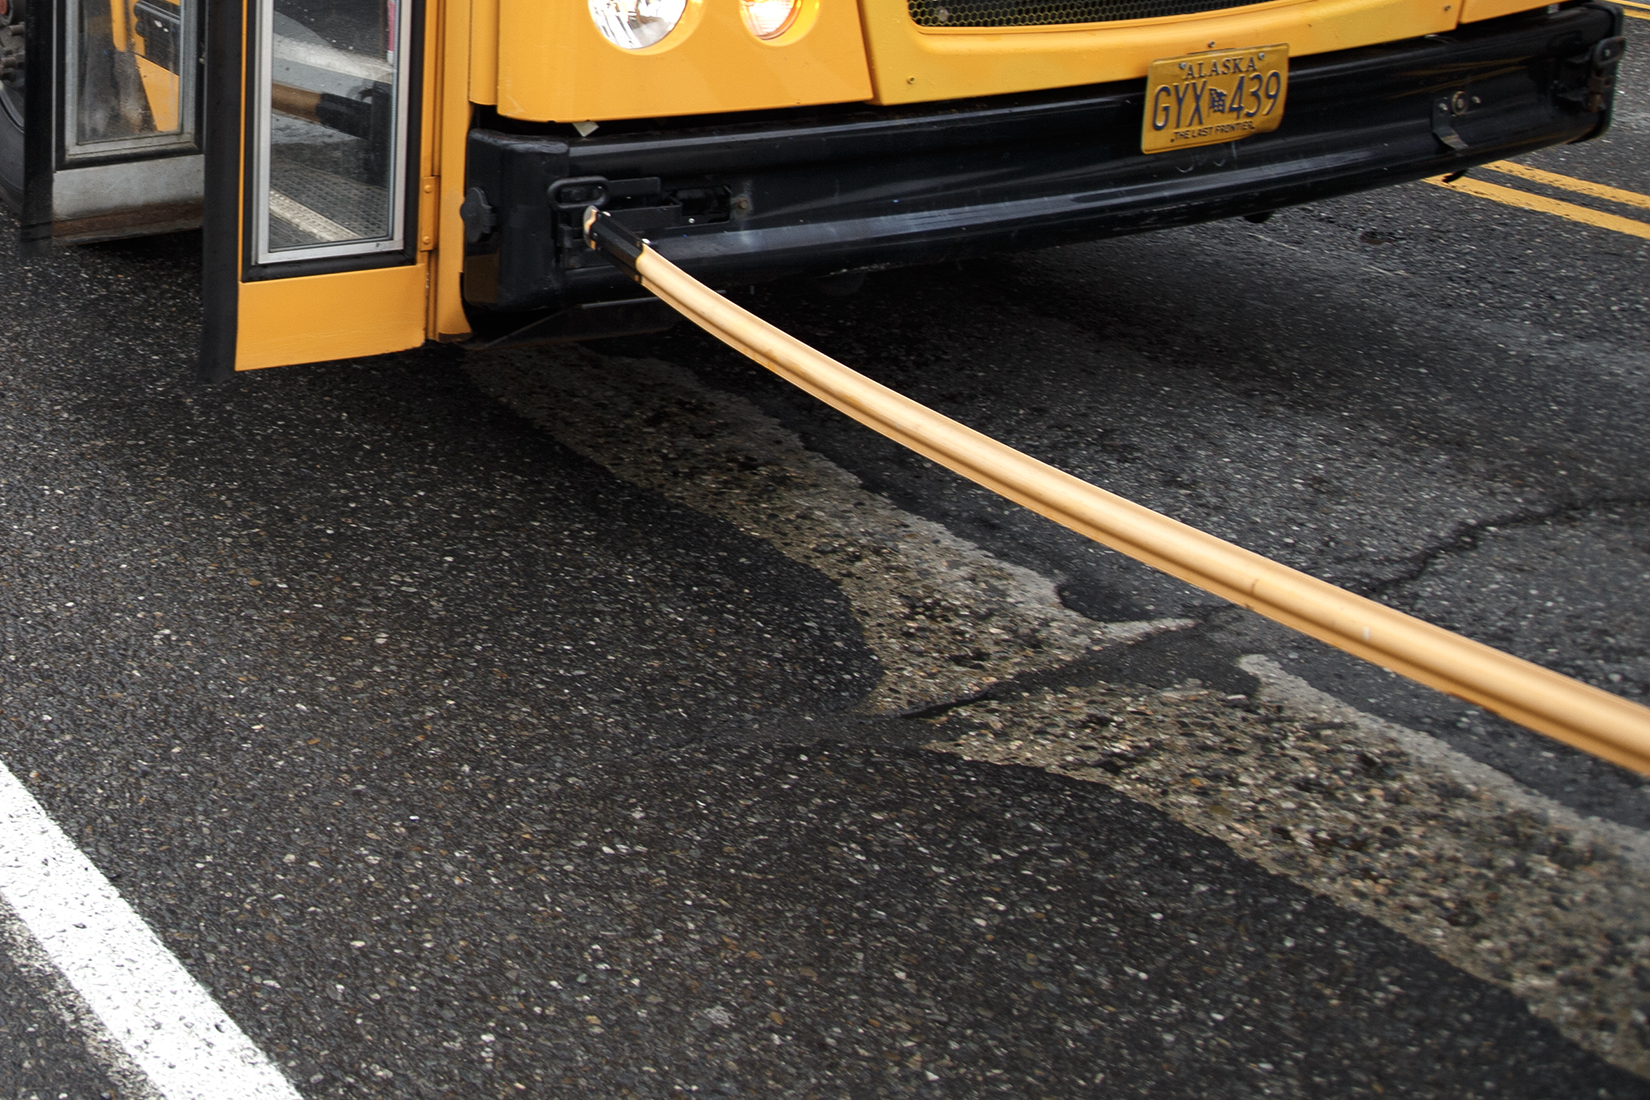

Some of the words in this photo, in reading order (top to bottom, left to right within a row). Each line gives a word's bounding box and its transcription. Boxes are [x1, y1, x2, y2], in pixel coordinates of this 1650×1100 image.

[1184, 56, 1258, 80] ALASKA
[1152, 79, 1208, 131] GYX
[1229, 70, 1281, 120] 439
[1173, 130, 1190, 140] THE
[1191, 126, 1213, 139] LAST
[1215, 120, 1255, 135] FRONTIER
